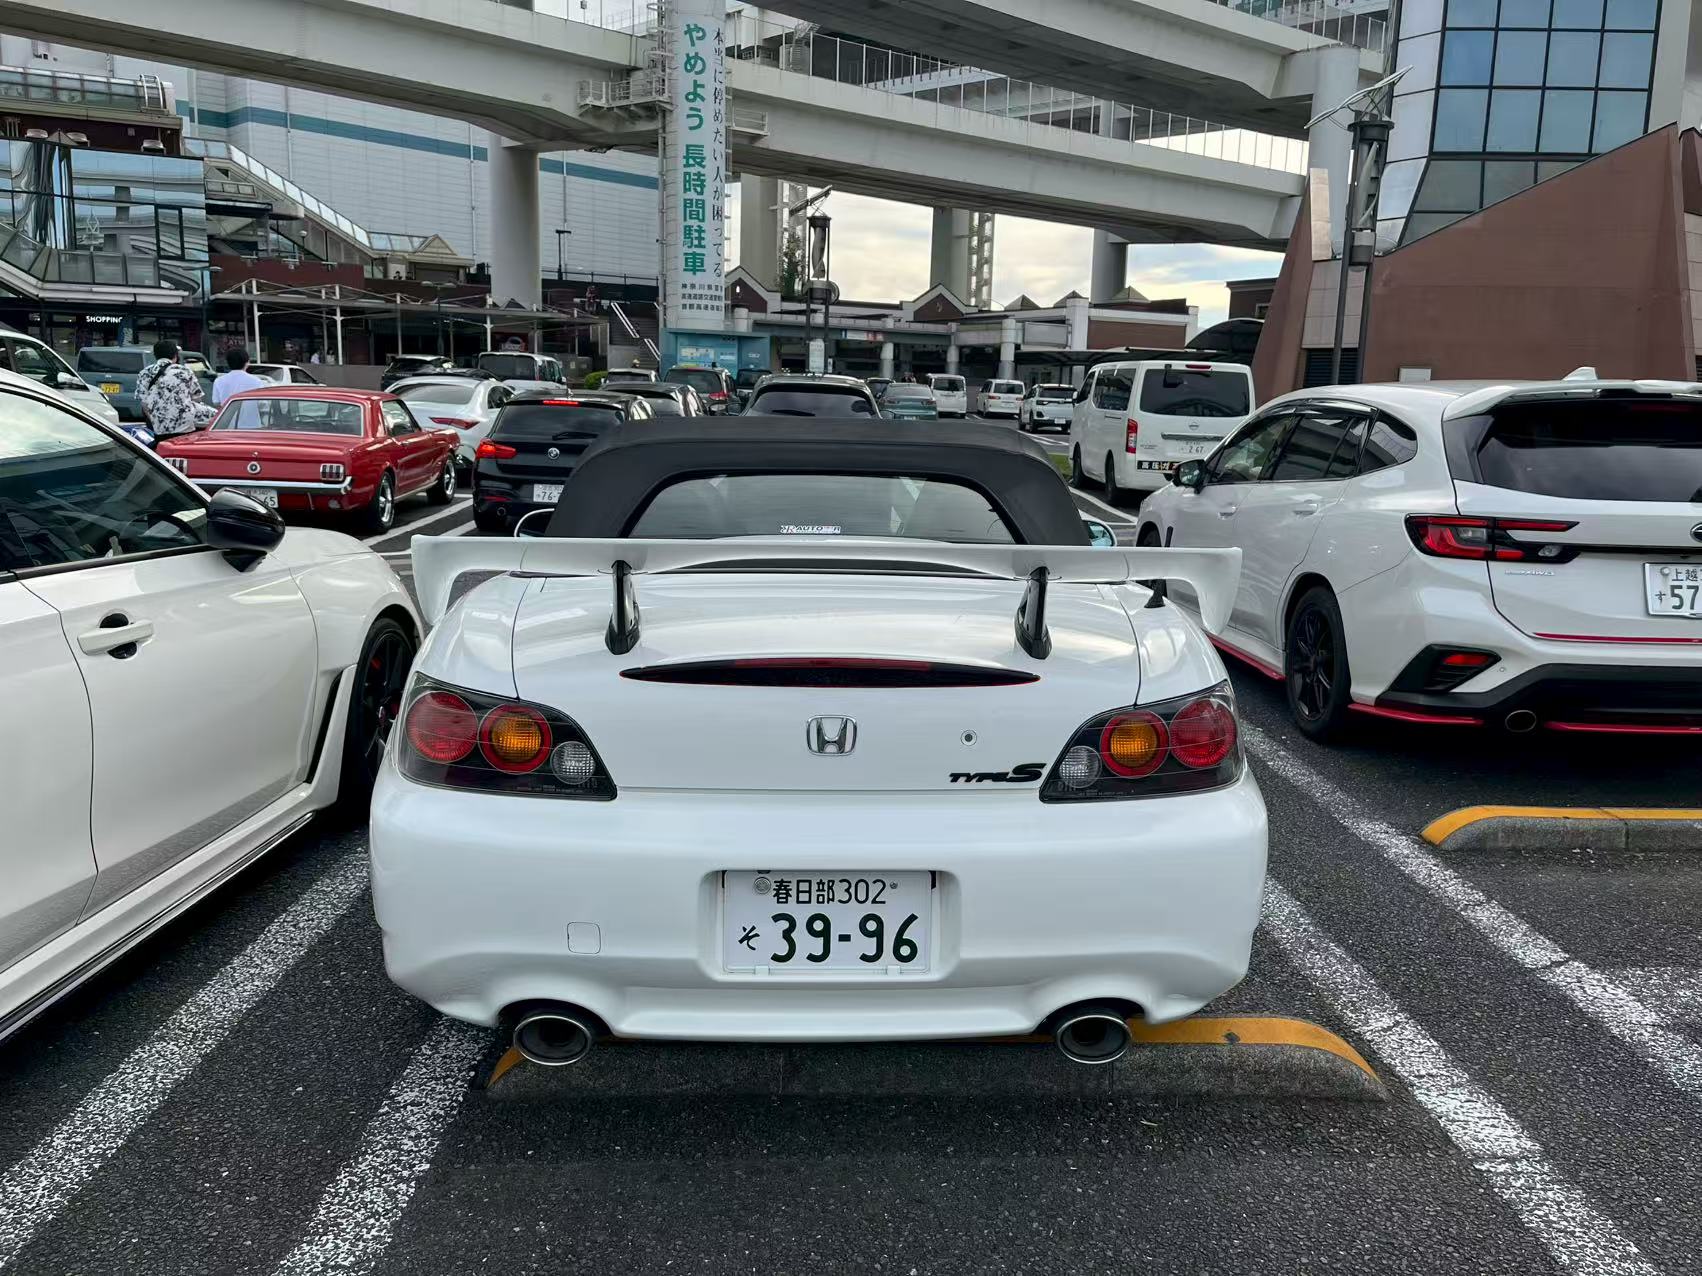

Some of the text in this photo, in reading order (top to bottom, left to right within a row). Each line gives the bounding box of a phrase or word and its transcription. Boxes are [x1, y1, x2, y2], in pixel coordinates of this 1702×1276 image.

[682, 23, 707, 276] やめよう 長時間駐車
[712, 27, 725, 278] 本当に停めたい人が困ってる
[1671, 568, 1702, 582] 上越
[773, 878, 887, 905] 春日部302
[738, 912, 919, 963] そ 39-96
